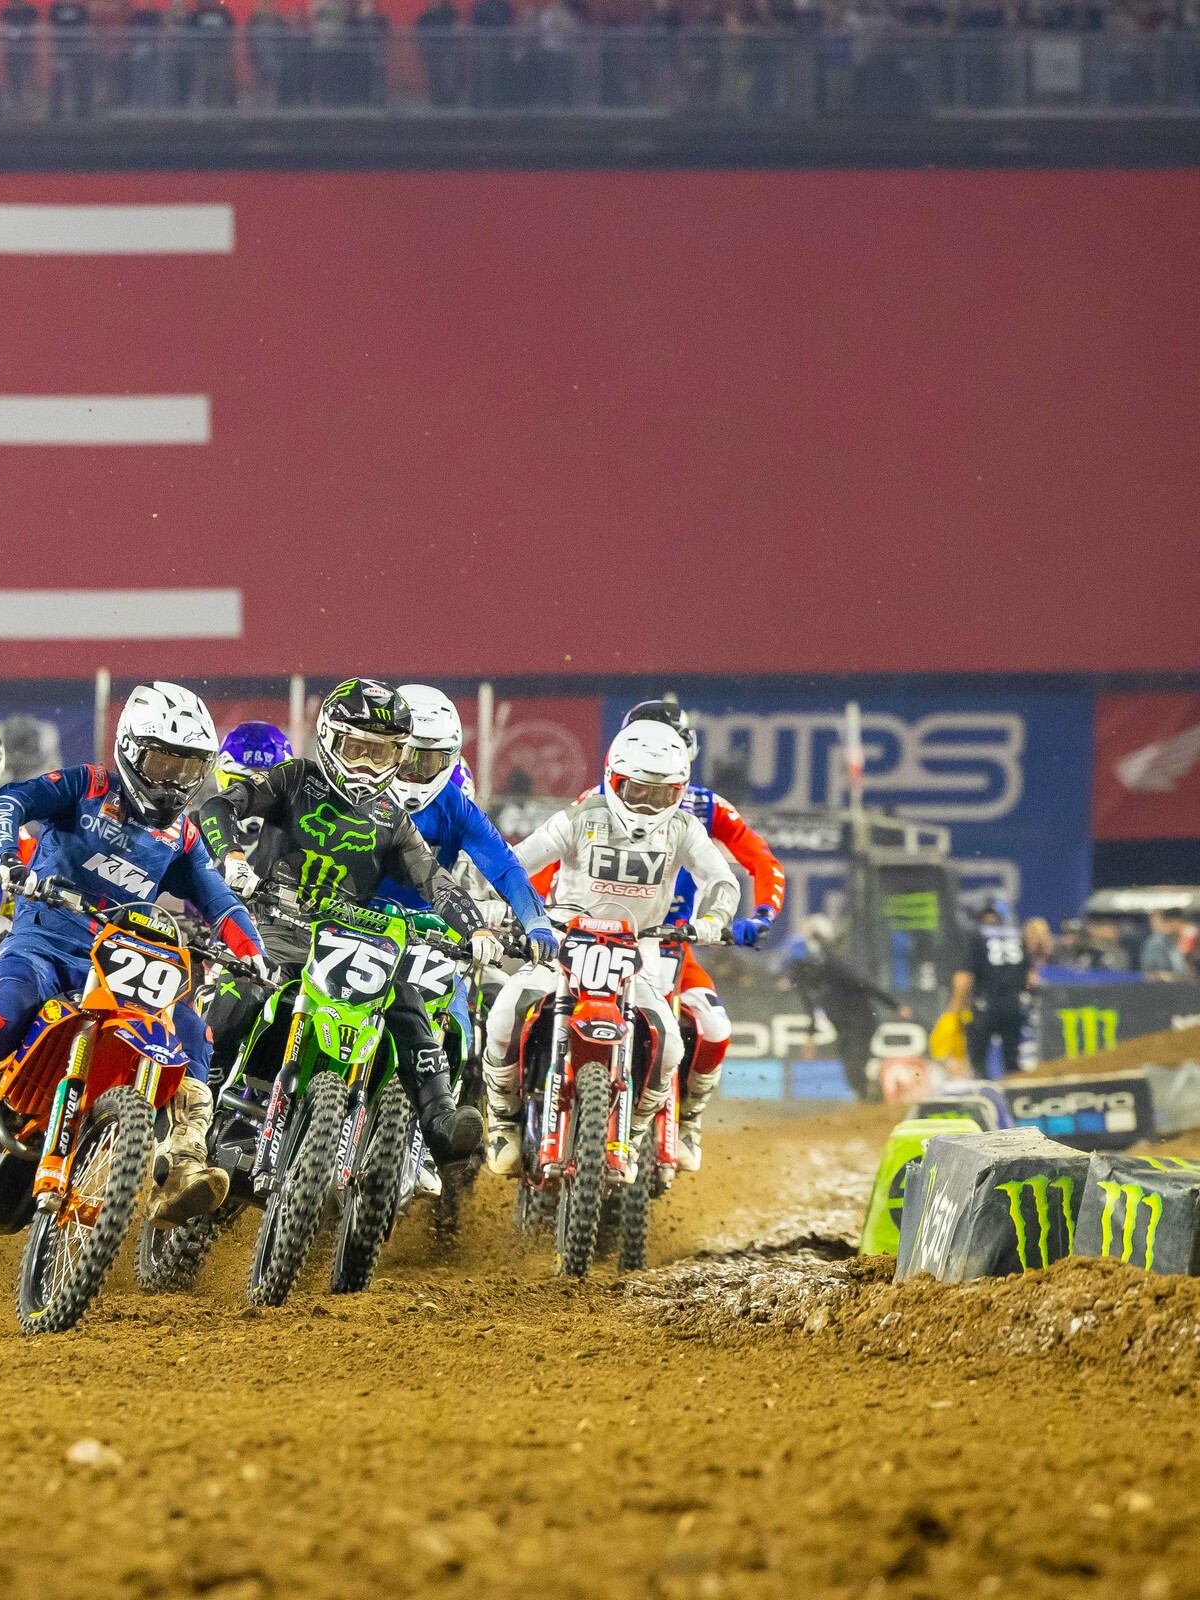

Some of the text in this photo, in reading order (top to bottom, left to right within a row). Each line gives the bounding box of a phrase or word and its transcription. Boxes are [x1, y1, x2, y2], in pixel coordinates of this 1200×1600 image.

[82, 852, 155, 899] KTM
[591, 845, 666, 885] FLY
[590, 881, 657, 899] GASGAS
[105, 948, 182, 1009] 29
[315, 932, 397, 995] 75
[408, 945, 457, 995] 12
[567, 943, 637, 992] 105
[59, 1087, 79, 1157] DUNOP
